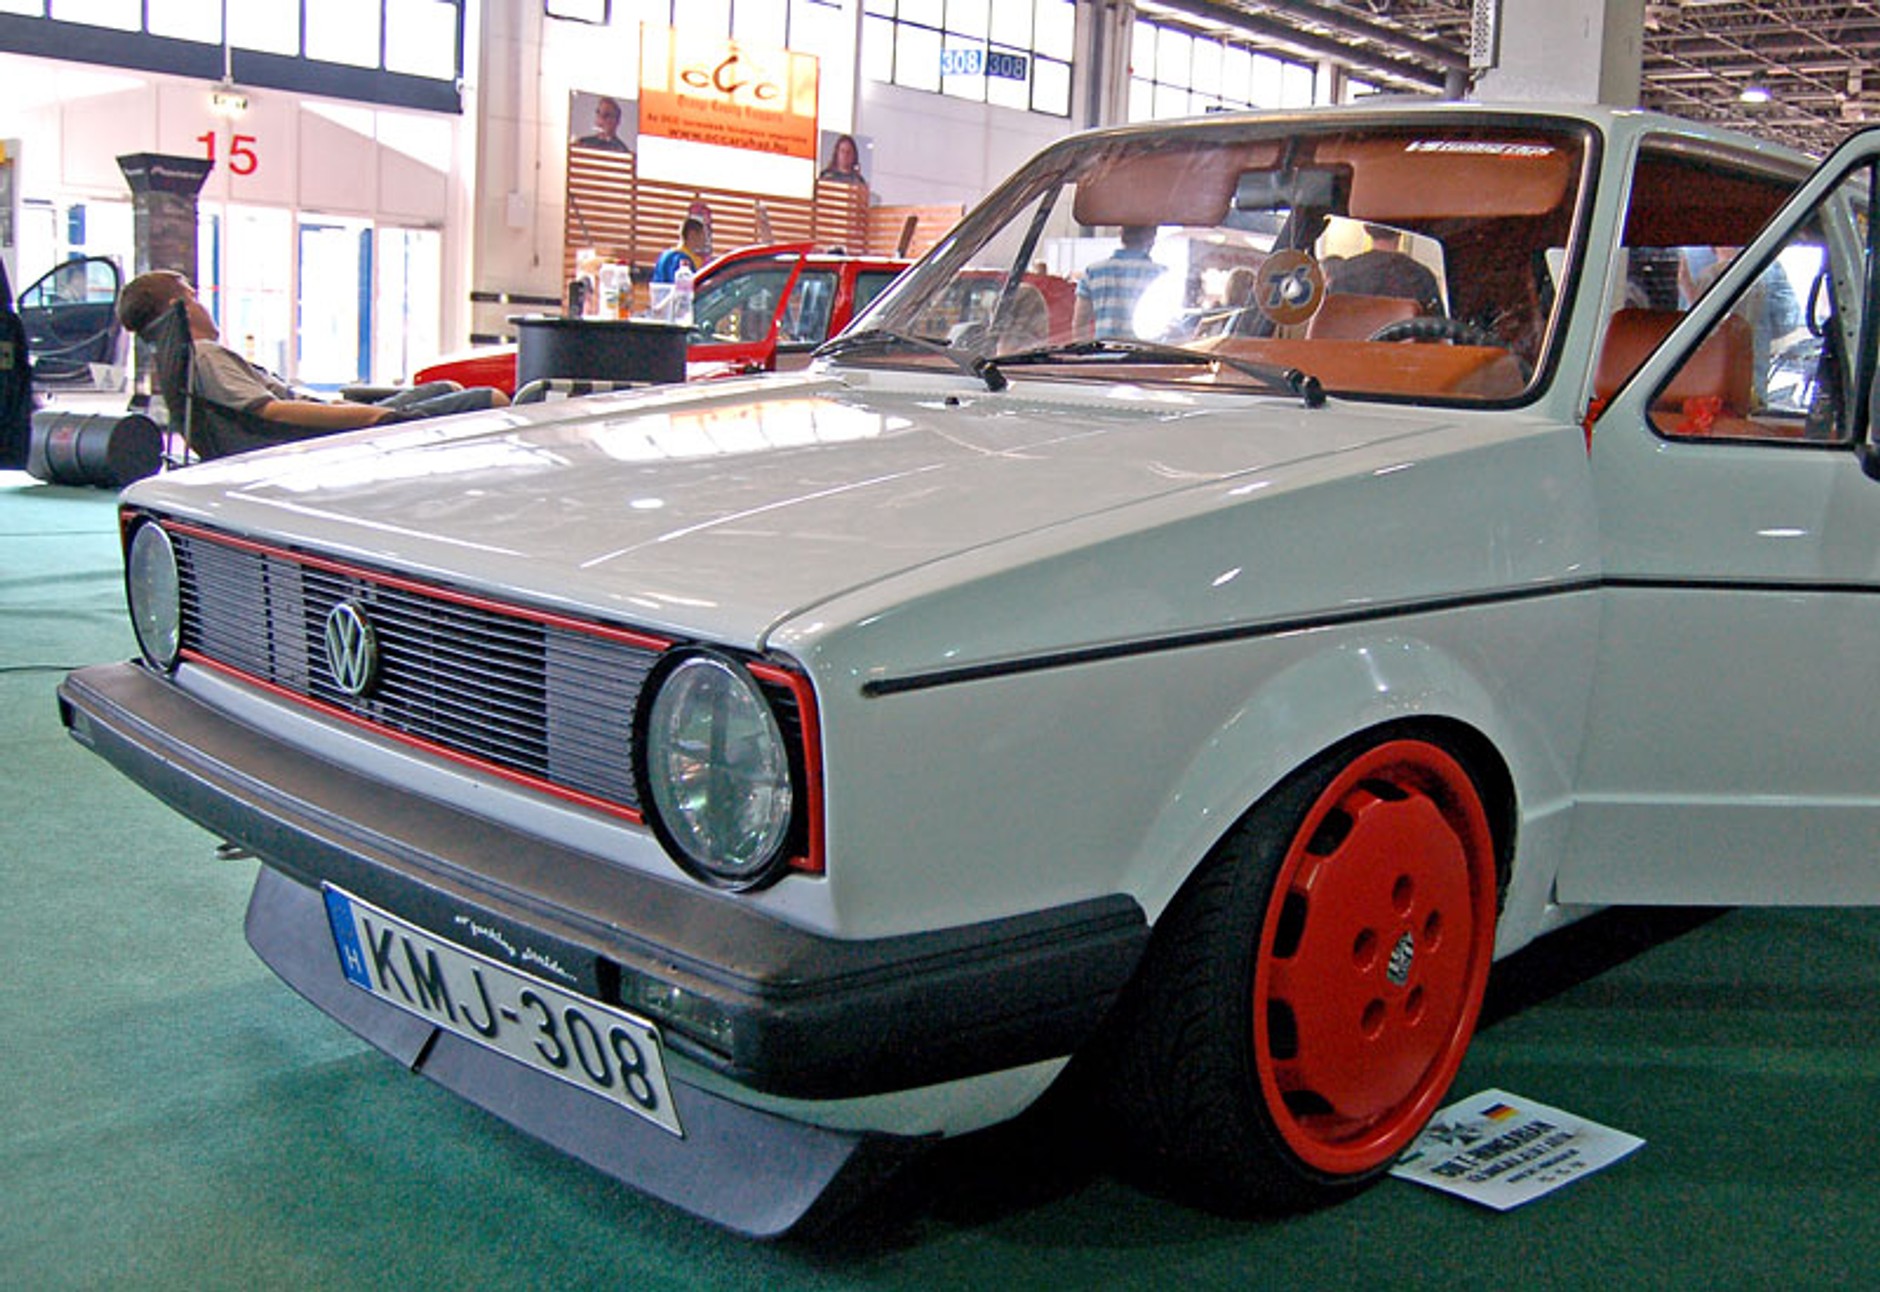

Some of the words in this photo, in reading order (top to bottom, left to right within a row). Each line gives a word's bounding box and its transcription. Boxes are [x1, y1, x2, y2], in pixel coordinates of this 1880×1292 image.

[942, 51, 979, 73] 308
[989, 54, 1025, 79] 308
[197, 131, 258, 175] 15
[345, 945, 361, 972] H
[363, 917, 657, 1110] KMJ-308
